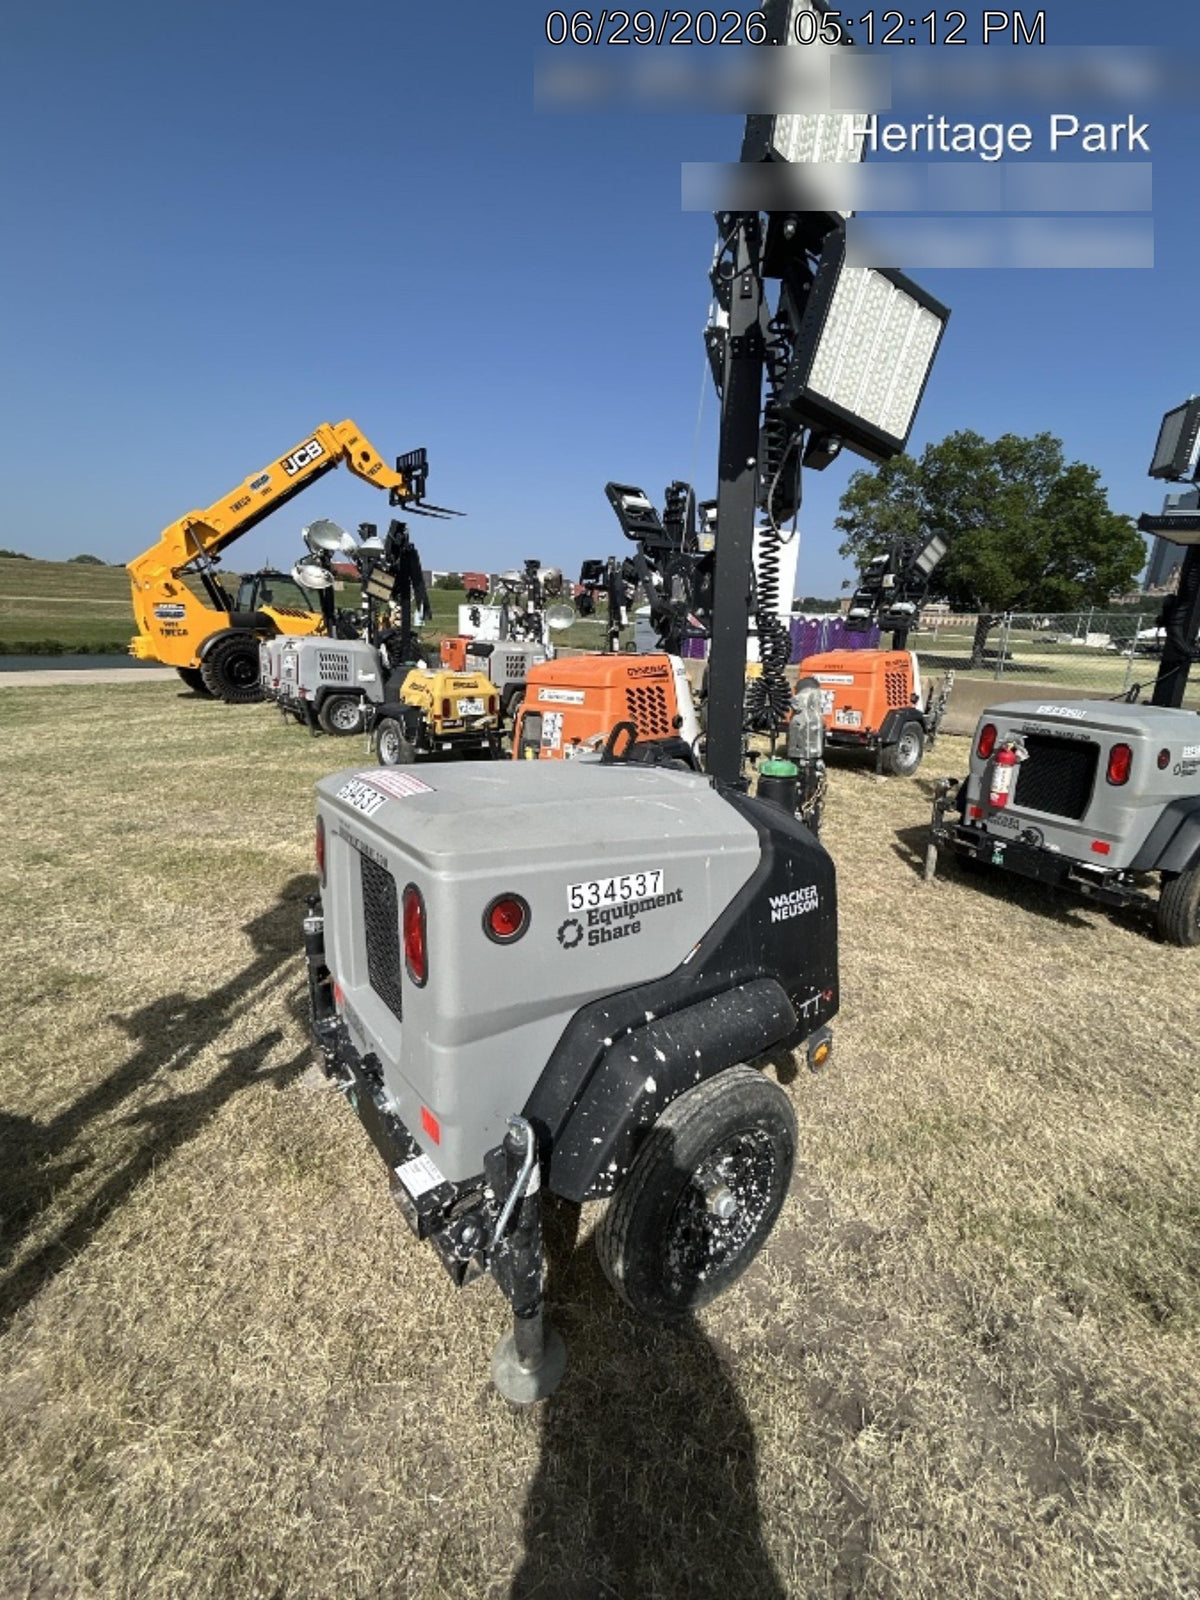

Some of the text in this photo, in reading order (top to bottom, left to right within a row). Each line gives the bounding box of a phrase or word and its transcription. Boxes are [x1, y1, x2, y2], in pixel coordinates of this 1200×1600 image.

[286, 440, 323, 475] JCB
[571, 871, 660, 909] 534537
[768, 885, 818, 909] WACKER
[587, 888, 683, 926] Equipment
[771, 896, 819, 923] NEUSON
[588, 921, 641, 946] Share
